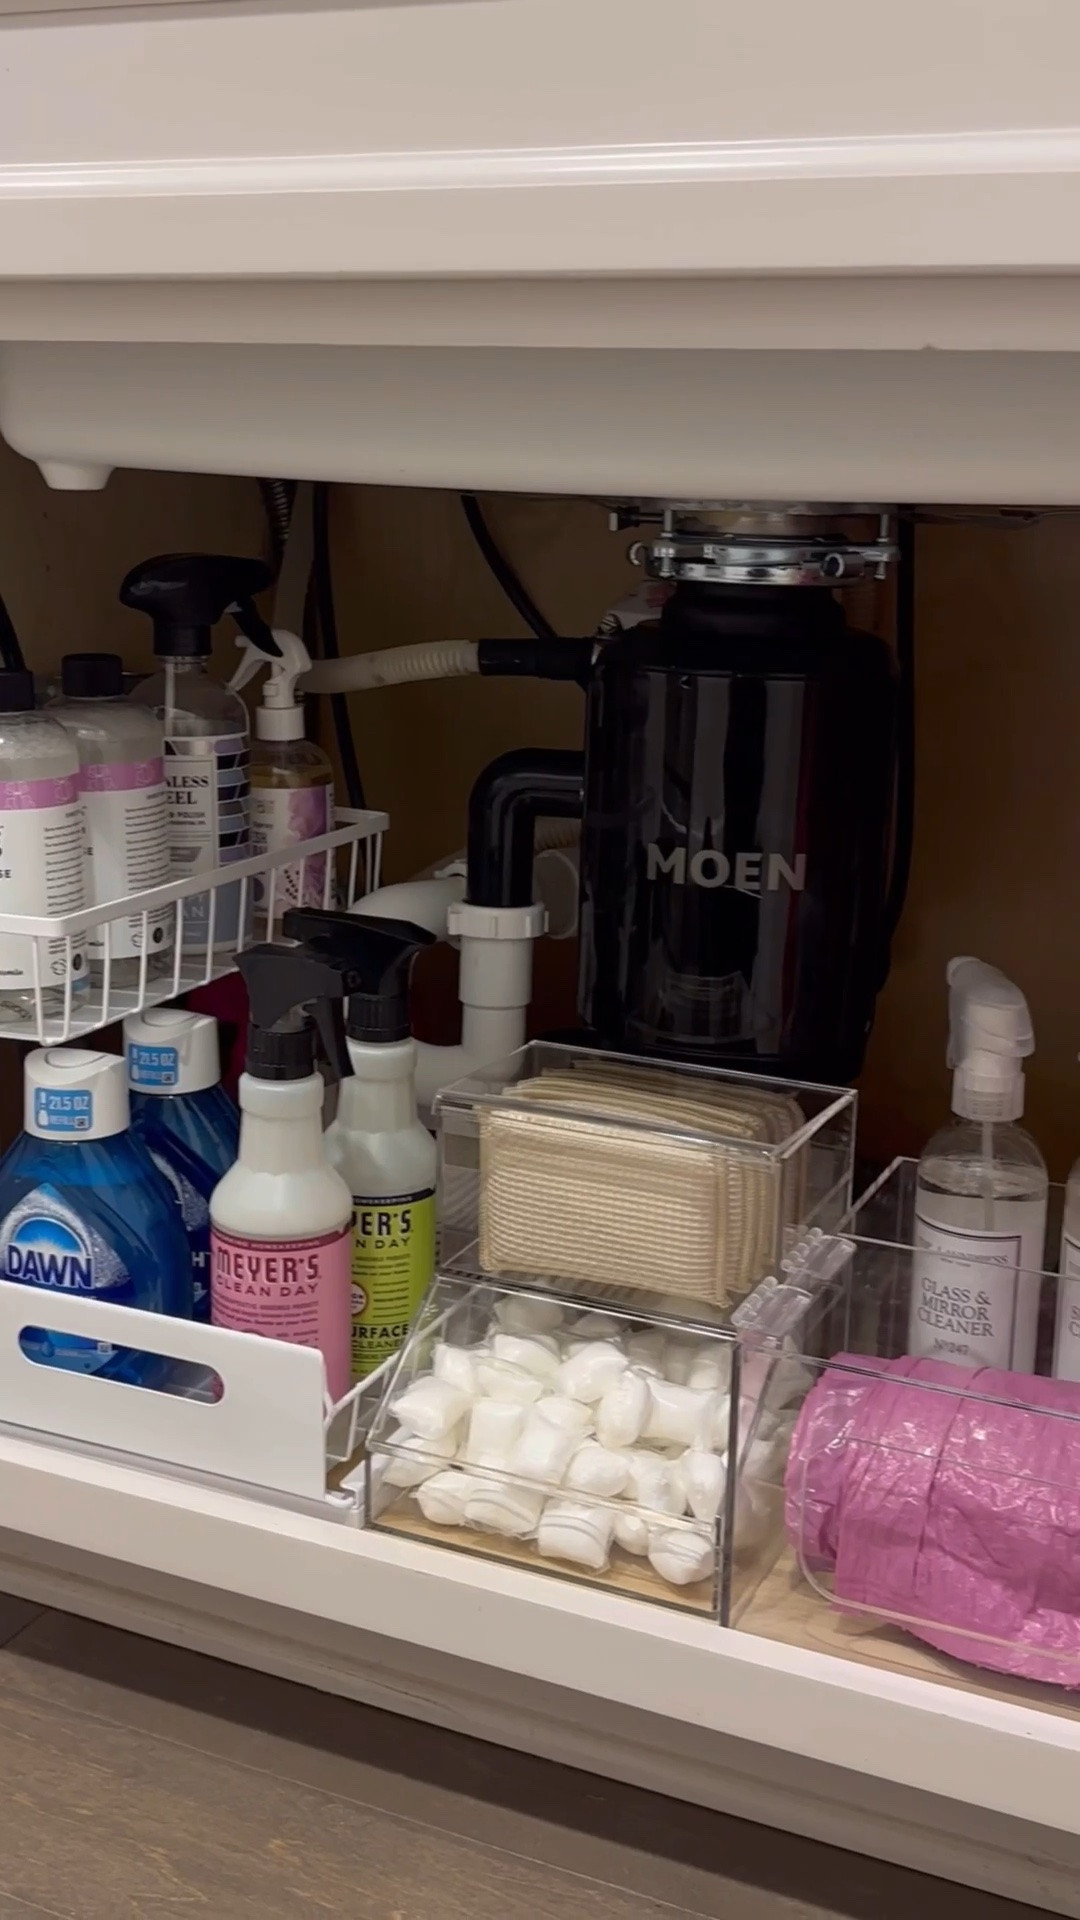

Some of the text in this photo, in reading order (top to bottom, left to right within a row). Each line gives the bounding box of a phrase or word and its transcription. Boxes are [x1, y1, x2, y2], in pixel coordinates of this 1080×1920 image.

[646, 842, 807, 891] MOEN
[73, 1095, 89, 1111] OZ
[375, 1236, 410, 1249] DAY
[7, 1245, 94, 1289] DAWN
[217, 1246, 319, 1283] MEYER'S
[216, 1274, 271, 1297] CLEAN
[280, 1282, 318, 1297] DAY
[922, 1277, 992, 1306] GLASS &
[921, 1292, 990, 1321] MIRROR
[918, 1307, 995, 1337] CLEANER
